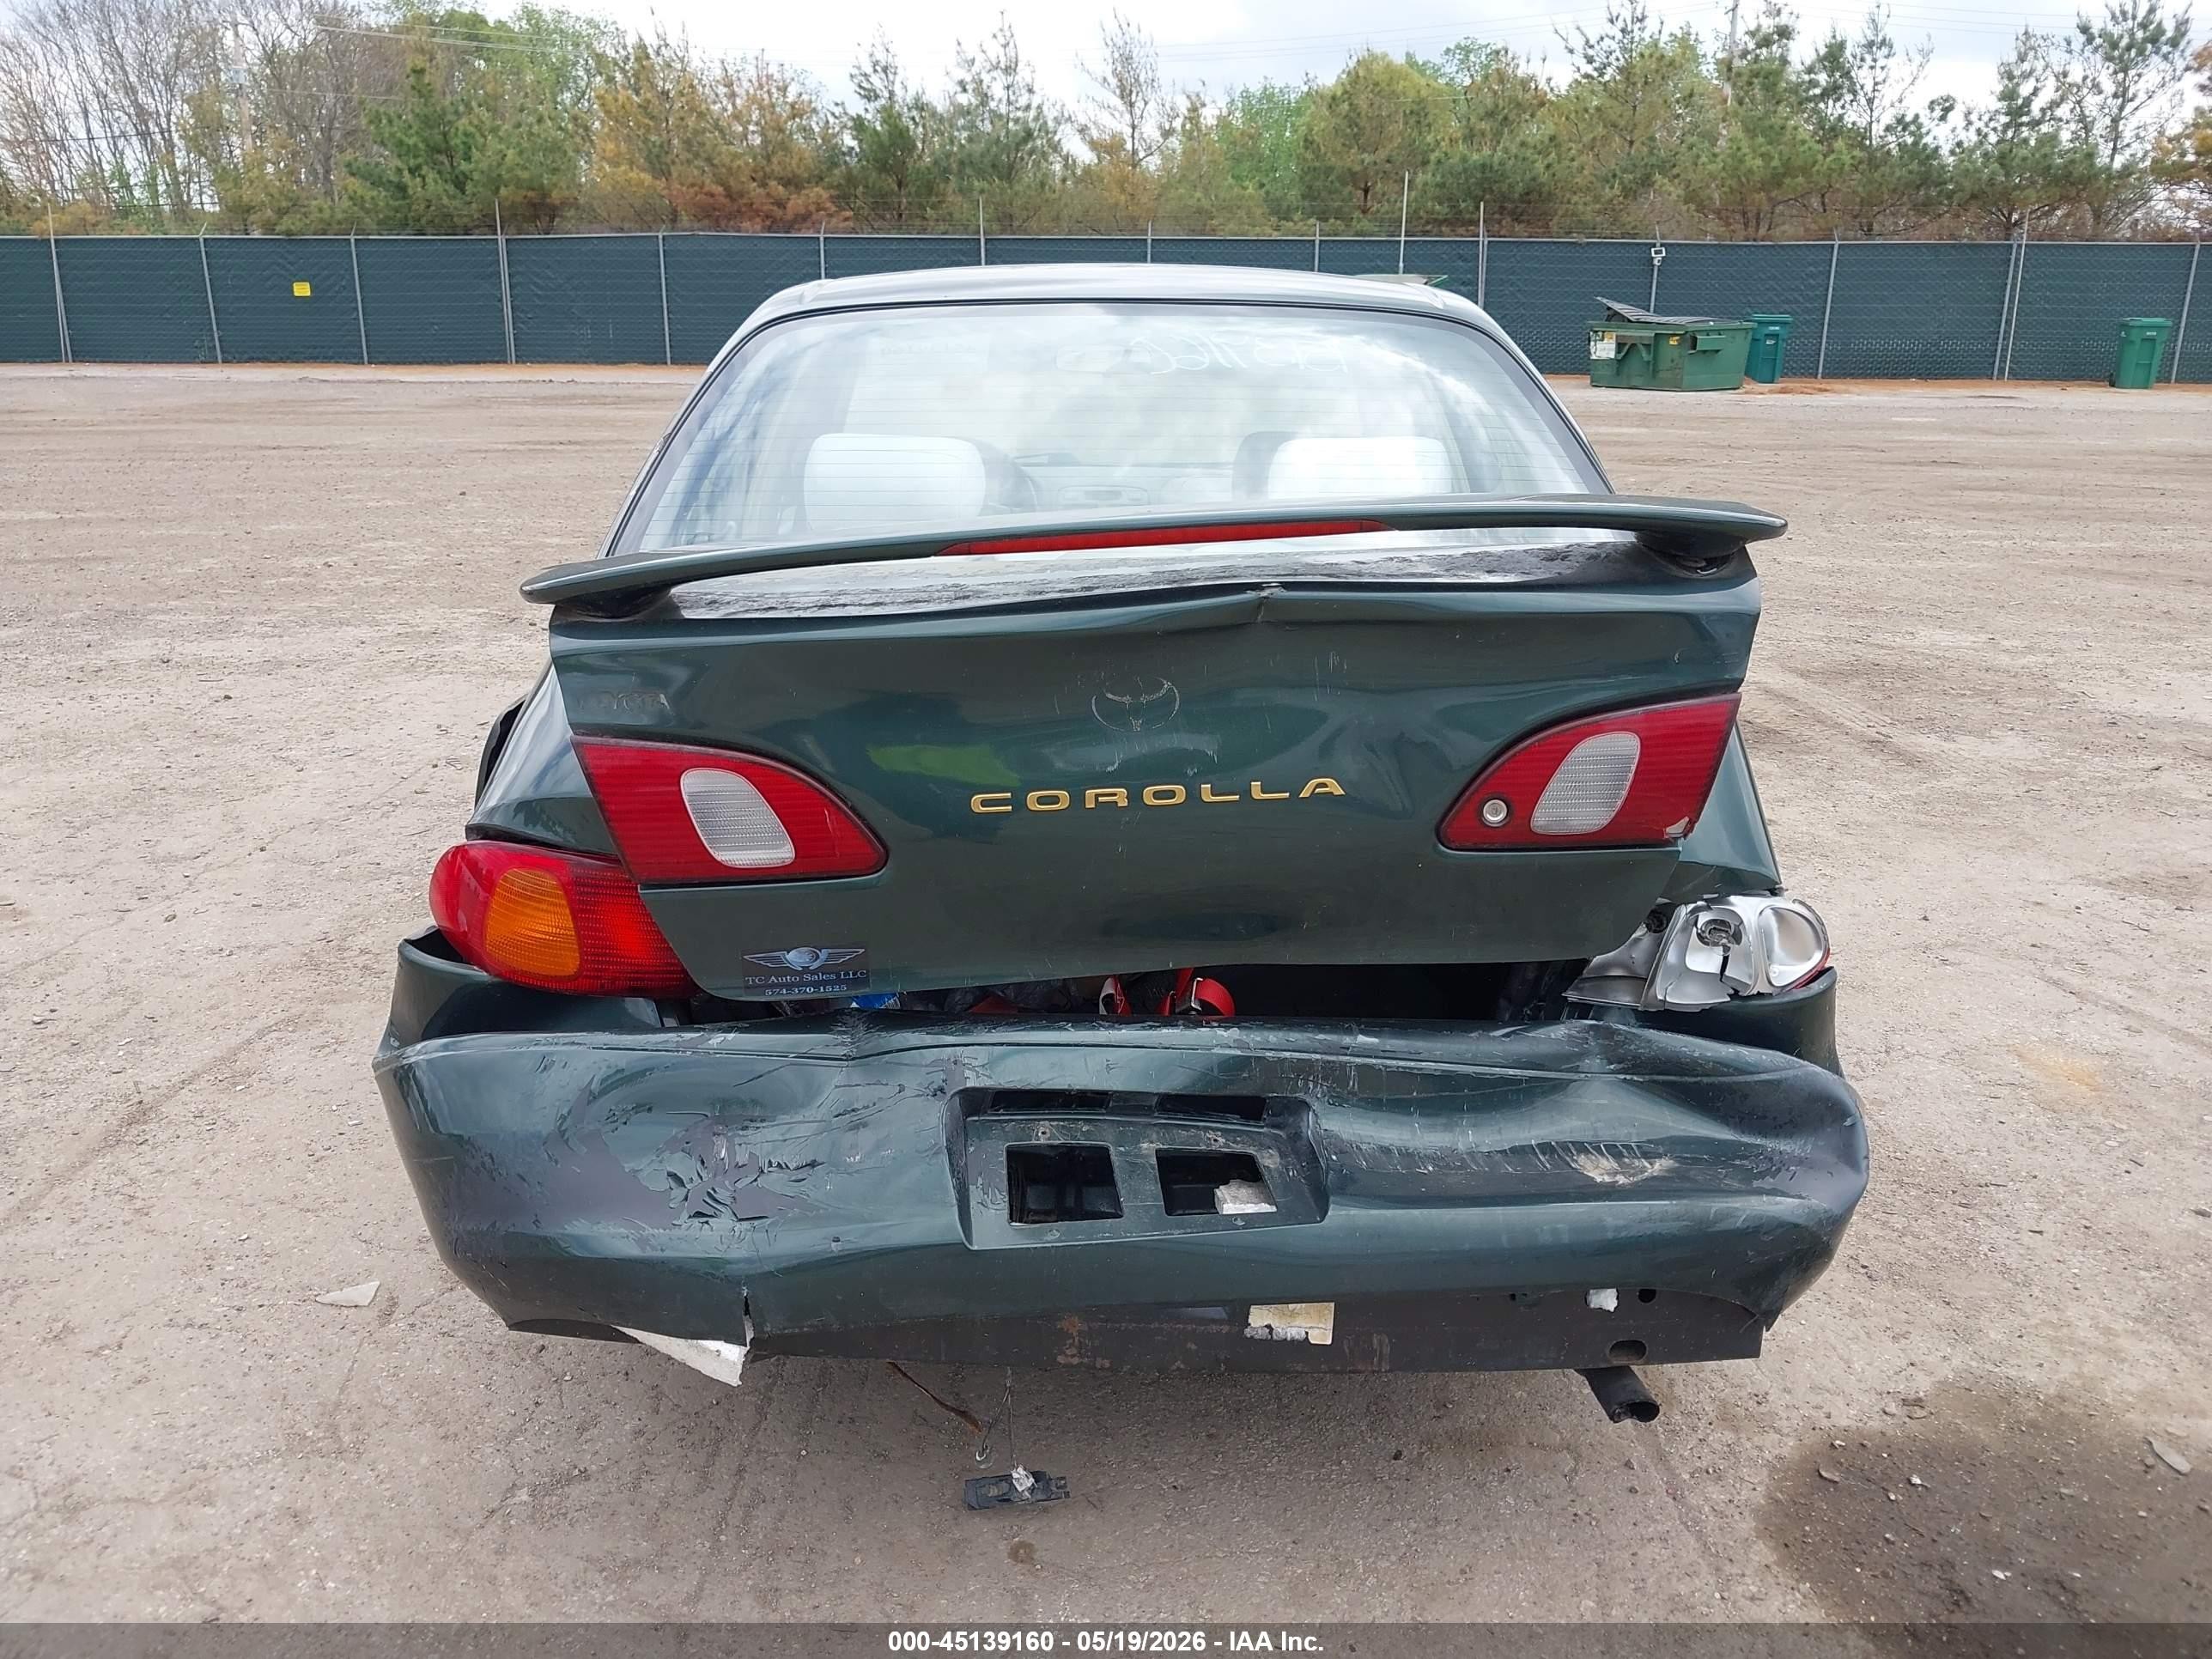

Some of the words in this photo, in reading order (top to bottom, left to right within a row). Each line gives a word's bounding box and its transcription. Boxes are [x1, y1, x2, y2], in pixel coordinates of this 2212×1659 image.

[969, 777, 1347, 814] COROLLA
[744, 975, 765, 985] TC
[767, 975, 799, 984] Auto
[803, 972, 836, 982] Sales
[841, 969, 866, 980] LLC
[764, 984, 848, 997] 574-370-1525
